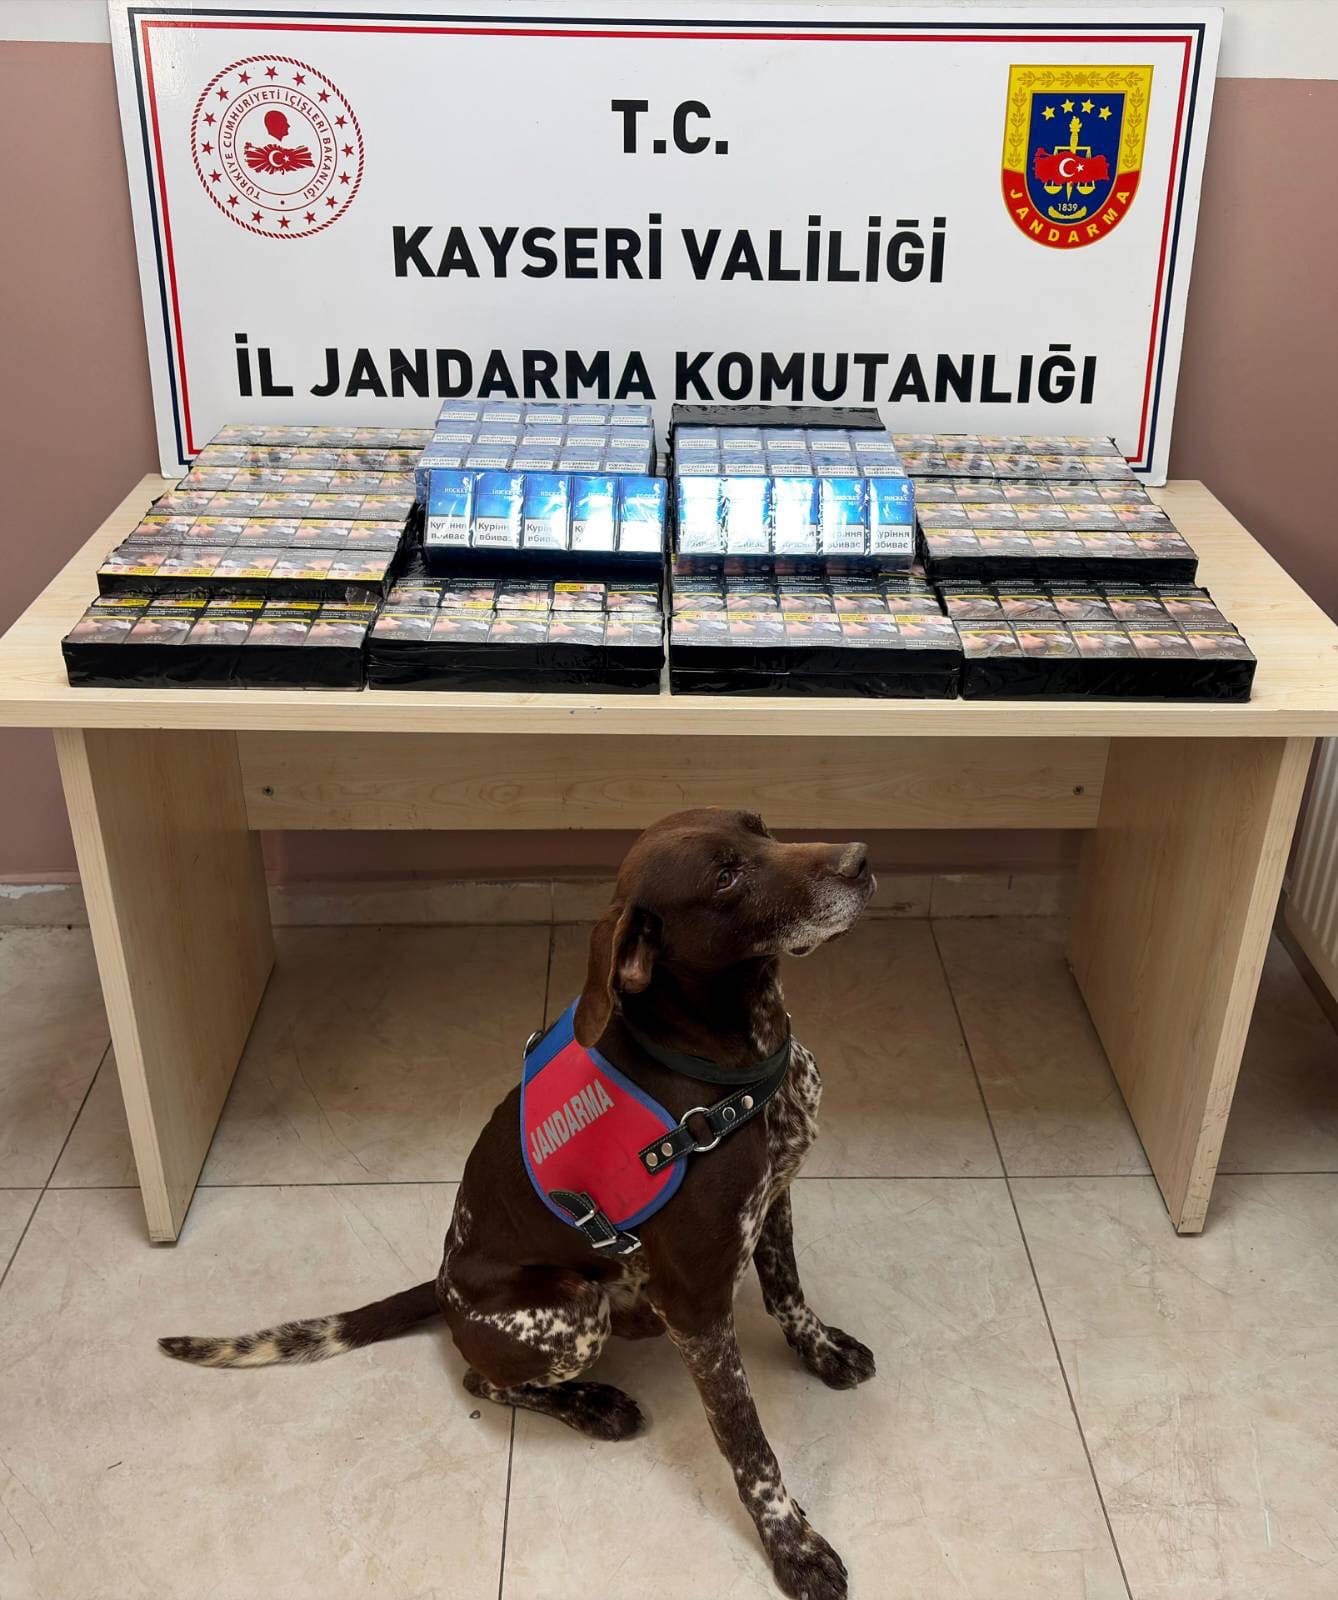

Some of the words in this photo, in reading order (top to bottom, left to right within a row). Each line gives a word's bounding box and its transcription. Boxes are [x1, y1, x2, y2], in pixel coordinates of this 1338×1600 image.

[223, 89, 280, 148] CUMHURİYETİ
[285, 91, 329, 133] İÇİŞLERİ
[611, 99, 729, 155] T.C.
[225, 153, 261, 200] TÜRKİYE
[303, 137, 333, 200] BAKANLIĞI
[1010, 189, 1130, 243] JANDARMA
[1057, 203, 1078, 212] 1839
[392, 213, 662, 279] KAYSERİ
[681, 215, 947, 282] VALİLİĞİ
[234, 333, 294, 397] İL
[309, 348, 657, 400] JANDARMA
[675, 343, 1098, 404] KOMUTANLIĞI
[530, 1079, 616, 1165] JANDARMA
